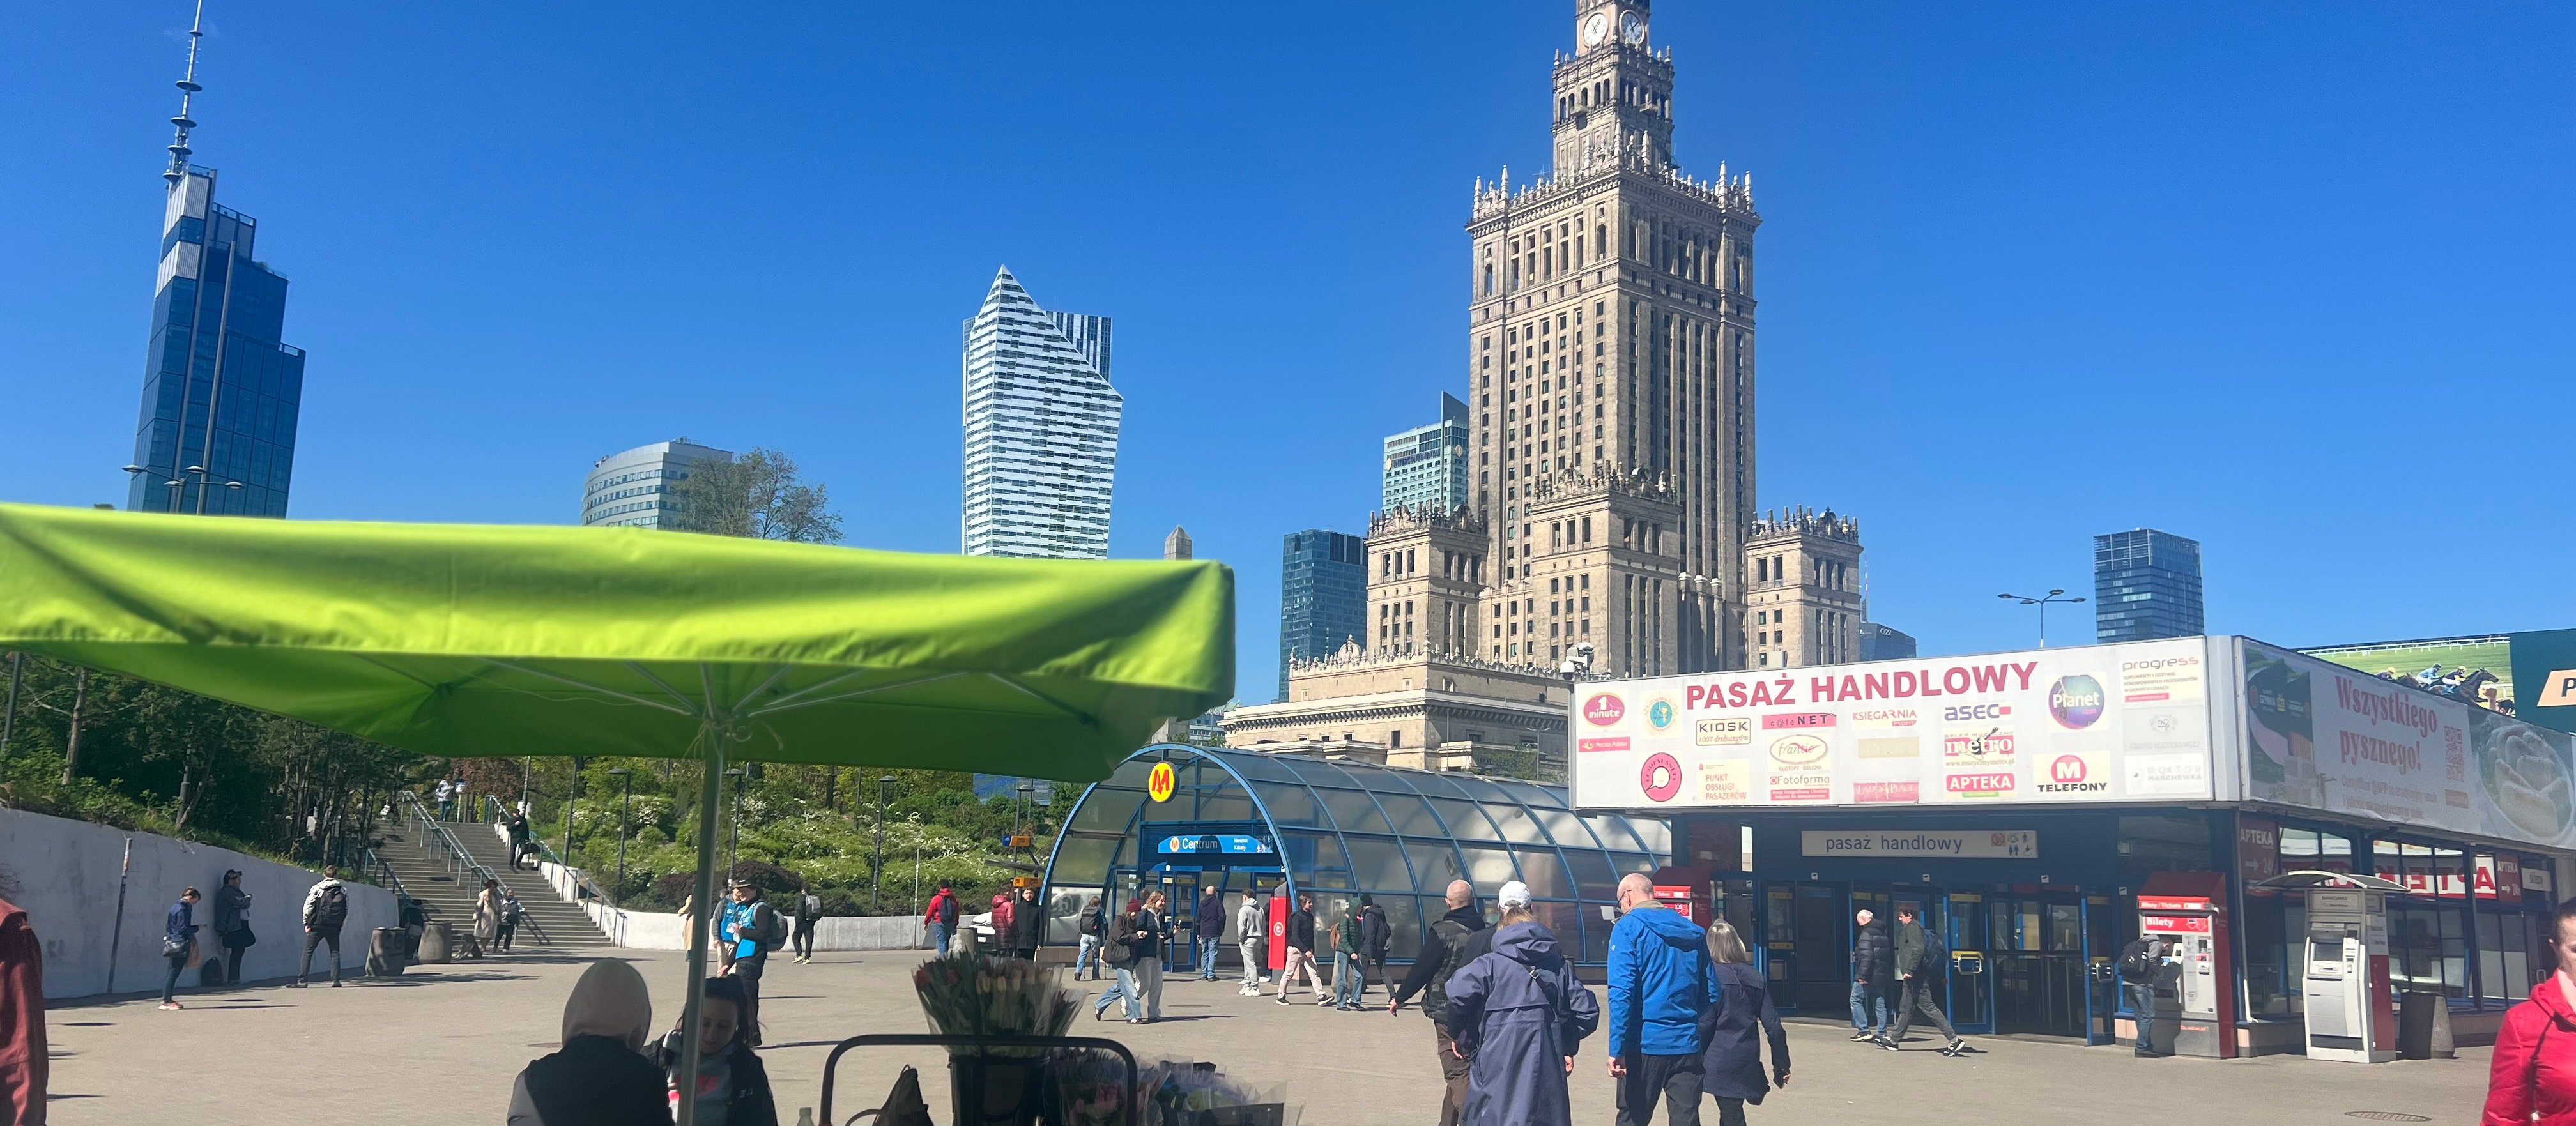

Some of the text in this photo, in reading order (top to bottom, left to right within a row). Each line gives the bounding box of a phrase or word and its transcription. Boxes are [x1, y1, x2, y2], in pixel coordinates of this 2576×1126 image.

[2122, 657, 2198, 672] progress
[1687, 662, 2038, 709] PASAŻ HANDLOWY
[1598, 696, 1607, 710] 1
[2053, 692, 2099, 708] Planet
[2335, 676, 2437, 738] Wszystkiego
[1589, 708, 1620, 718] minute
[1853, 709, 1917, 720] KSIĘGARNIA
[1699, 722, 1748, 733] KIOSK
[1945, 736, 2012, 754] metro
[2340, 730, 2421, 775] pysznego!
[2057, 761, 2081, 779] M
[1151, 769, 1170, 795] M
[1777, 775, 1829, 784] Fotoforma
[1949, 775, 2012, 789] APTEKA
[2037, 782, 2107, 792] TELEFONY
[1182, 838, 1218, 849] Centrum
[1826, 835, 1963, 853] pasaż handlowy
[2240, 828, 2273, 846] APTEKA
[2497, 861, 2518, 874] APTEKA
[2147, 917, 2174, 927] Bilety
